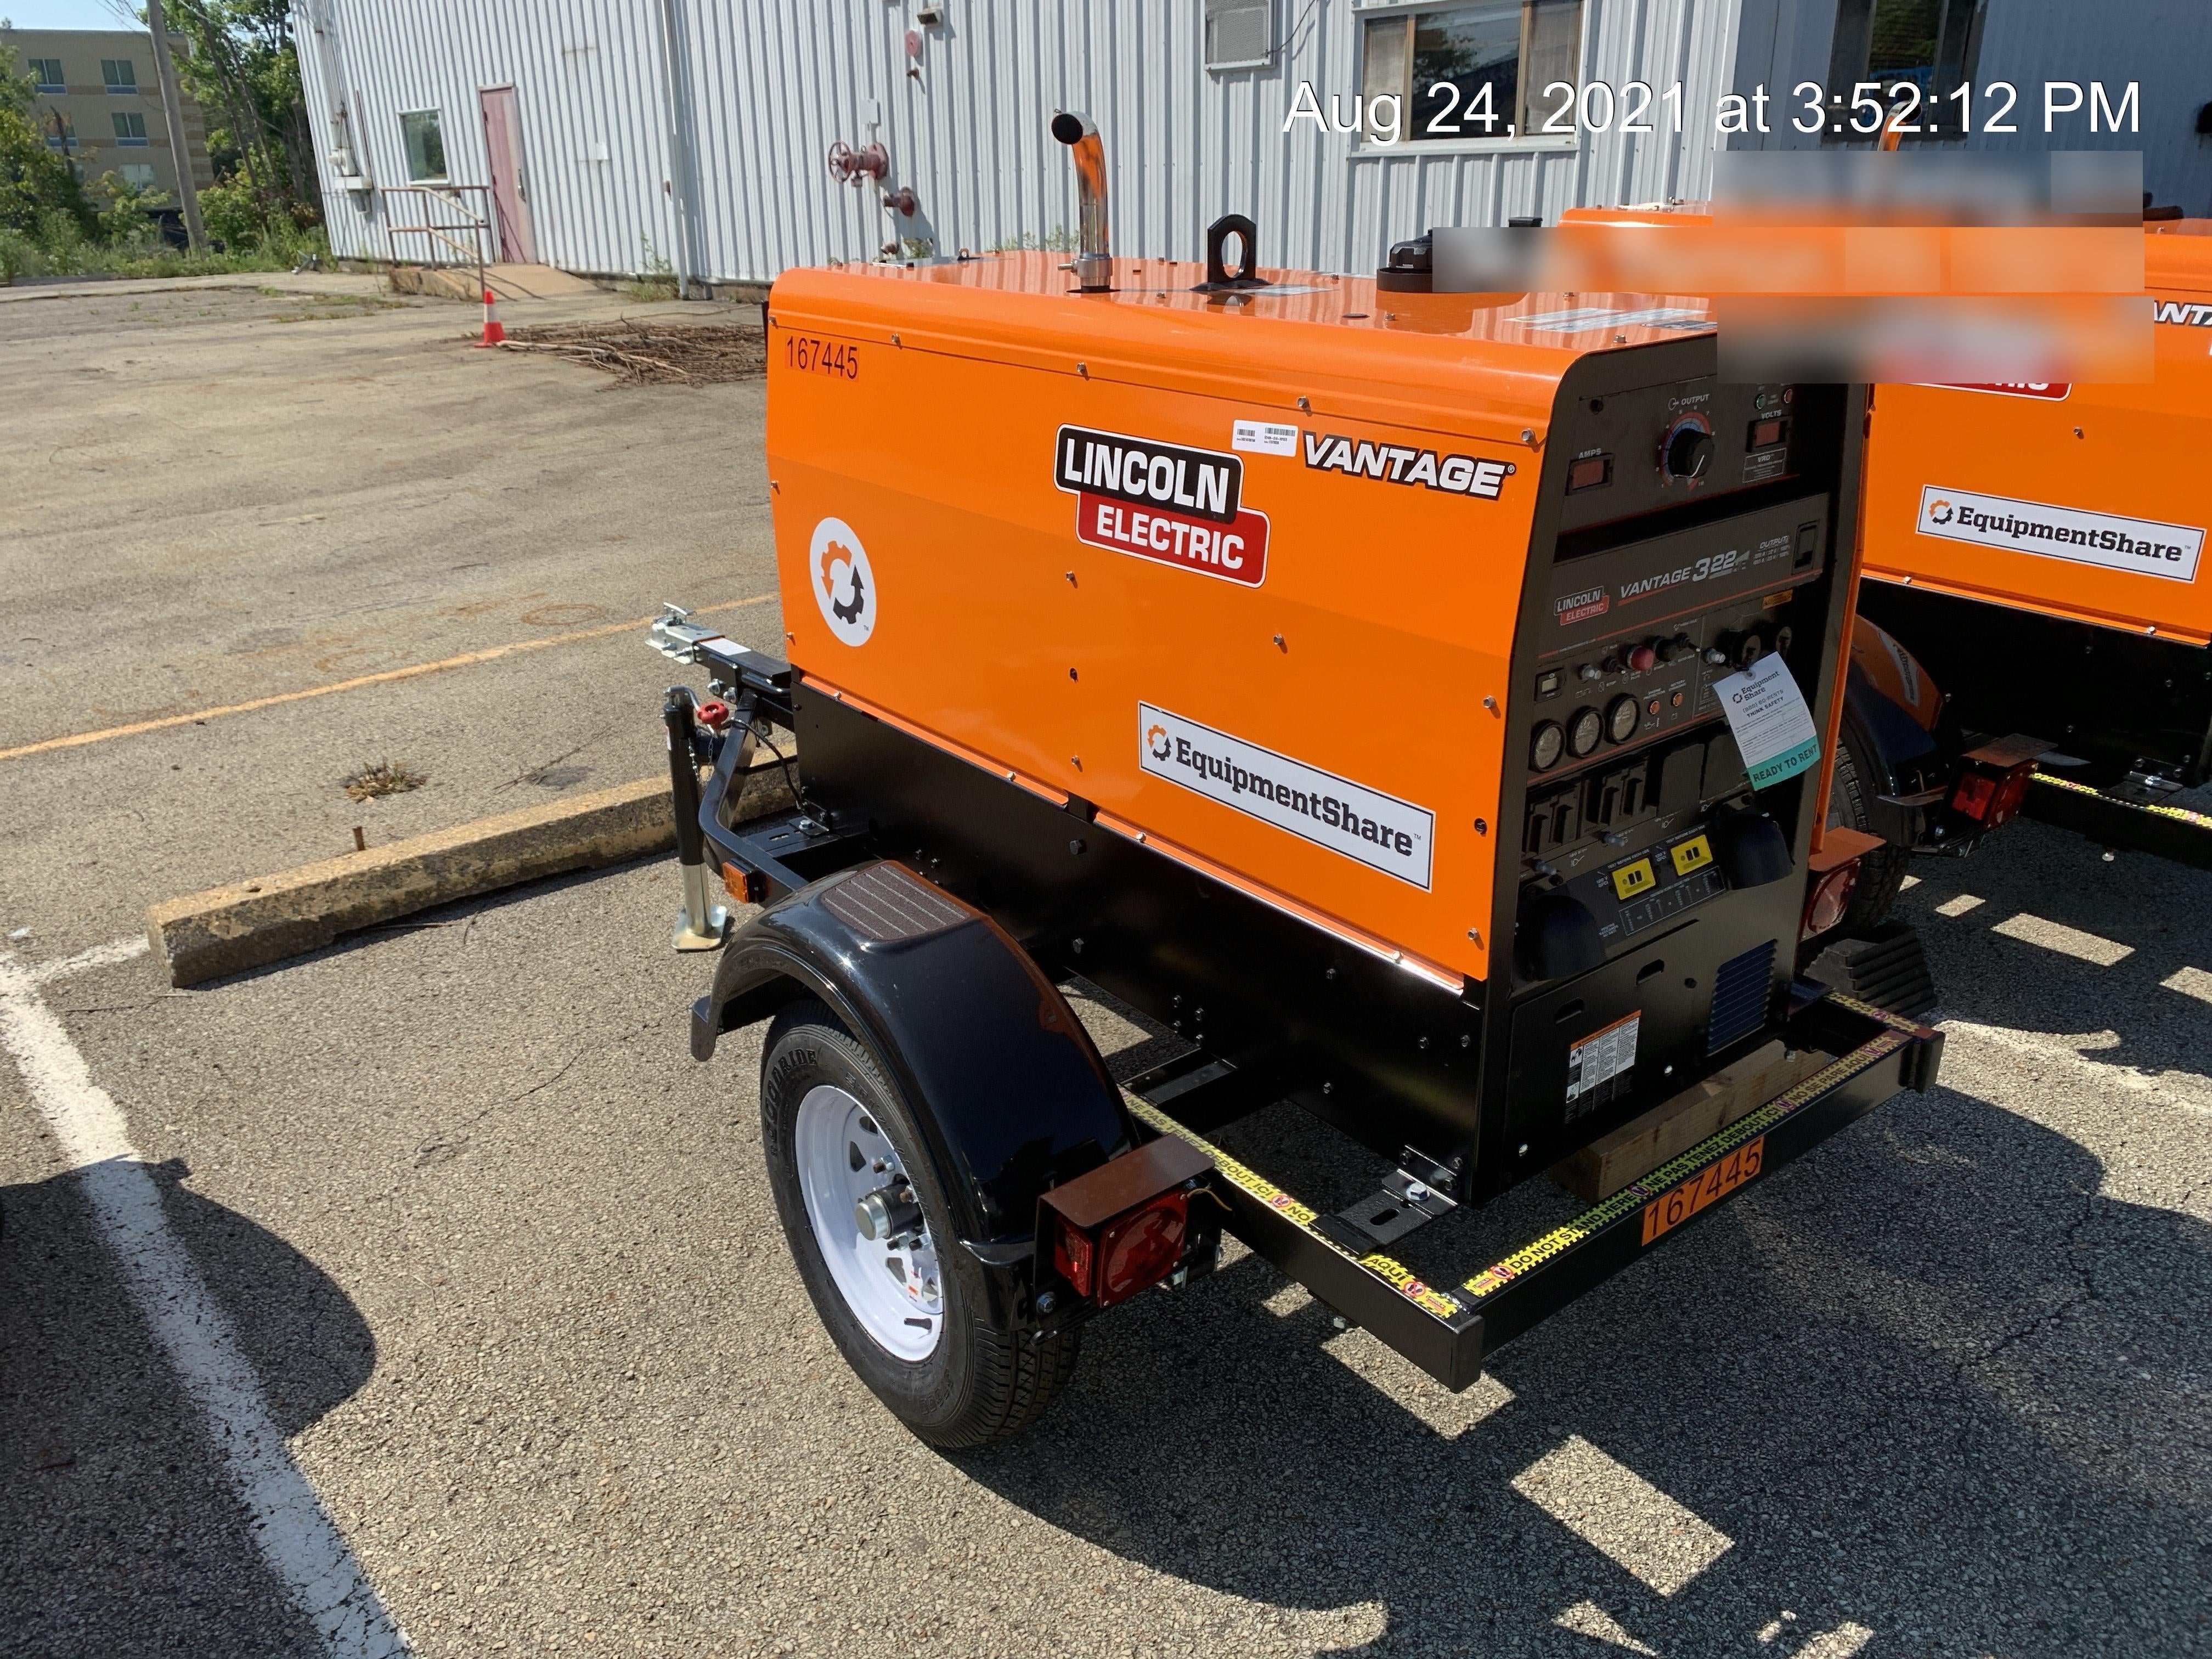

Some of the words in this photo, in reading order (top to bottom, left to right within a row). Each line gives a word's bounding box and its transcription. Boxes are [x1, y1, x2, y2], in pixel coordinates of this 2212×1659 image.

[787, 335, 858, 380] 167445
[1680, 393, 1710, 407] OUTPUT
[1760, 409, 1782, 420] VOLTS
[1578, 448, 1602, 460] AMPS
[1064, 438, 1229, 514] LINCOLN
[1097, 504, 1245, 569] ELECTRIC
[1620, 566, 1693, 599] VANTAGE
[1692, 550, 1737, 583] 322
[1557, 589, 1601, 612] LINCOLN
[1566, 602, 1604, 621] ELECTRIC
[1741, 670, 1780, 694] Equipment
[1745, 686, 1766, 702] Share
[1746, 707, 1765, 719] THINK
[1764, 696, 1785, 709] SAFETY
[1752, 763, 1783, 783] READY
[1784, 756, 1798, 769] TO
[1798, 743, 1818, 764] RENT
[1791, 1090, 1809, 1102] NO
[1808, 1081, 1821, 1093] SE
[1819, 1066, 1844, 1085] PARE
[1126, 1098, 1145, 1110] NE
[1143, 1108, 1167, 1125] PAS
[1256, 1183, 1275, 1197] ICI
[1646, 1175, 1664, 1188] NE
[1663, 1161, 1689, 1178] PAS
[1686, 1141, 1723, 1163] TENEZ
[1720, 1115, 1766, 1143] DEBOUT
[1765, 1107, 1781, 1118] ICI
[1648, 1139, 1761, 1237] 167445
[1288, 1205, 1311, 1222] NO
[1509, 1255, 1533, 1269] DO
[1532, 1237, 1562, 1257] NOT
[1559, 1214, 1604, 1241] STAND
[1602, 1193, 1637, 1216] HERE
